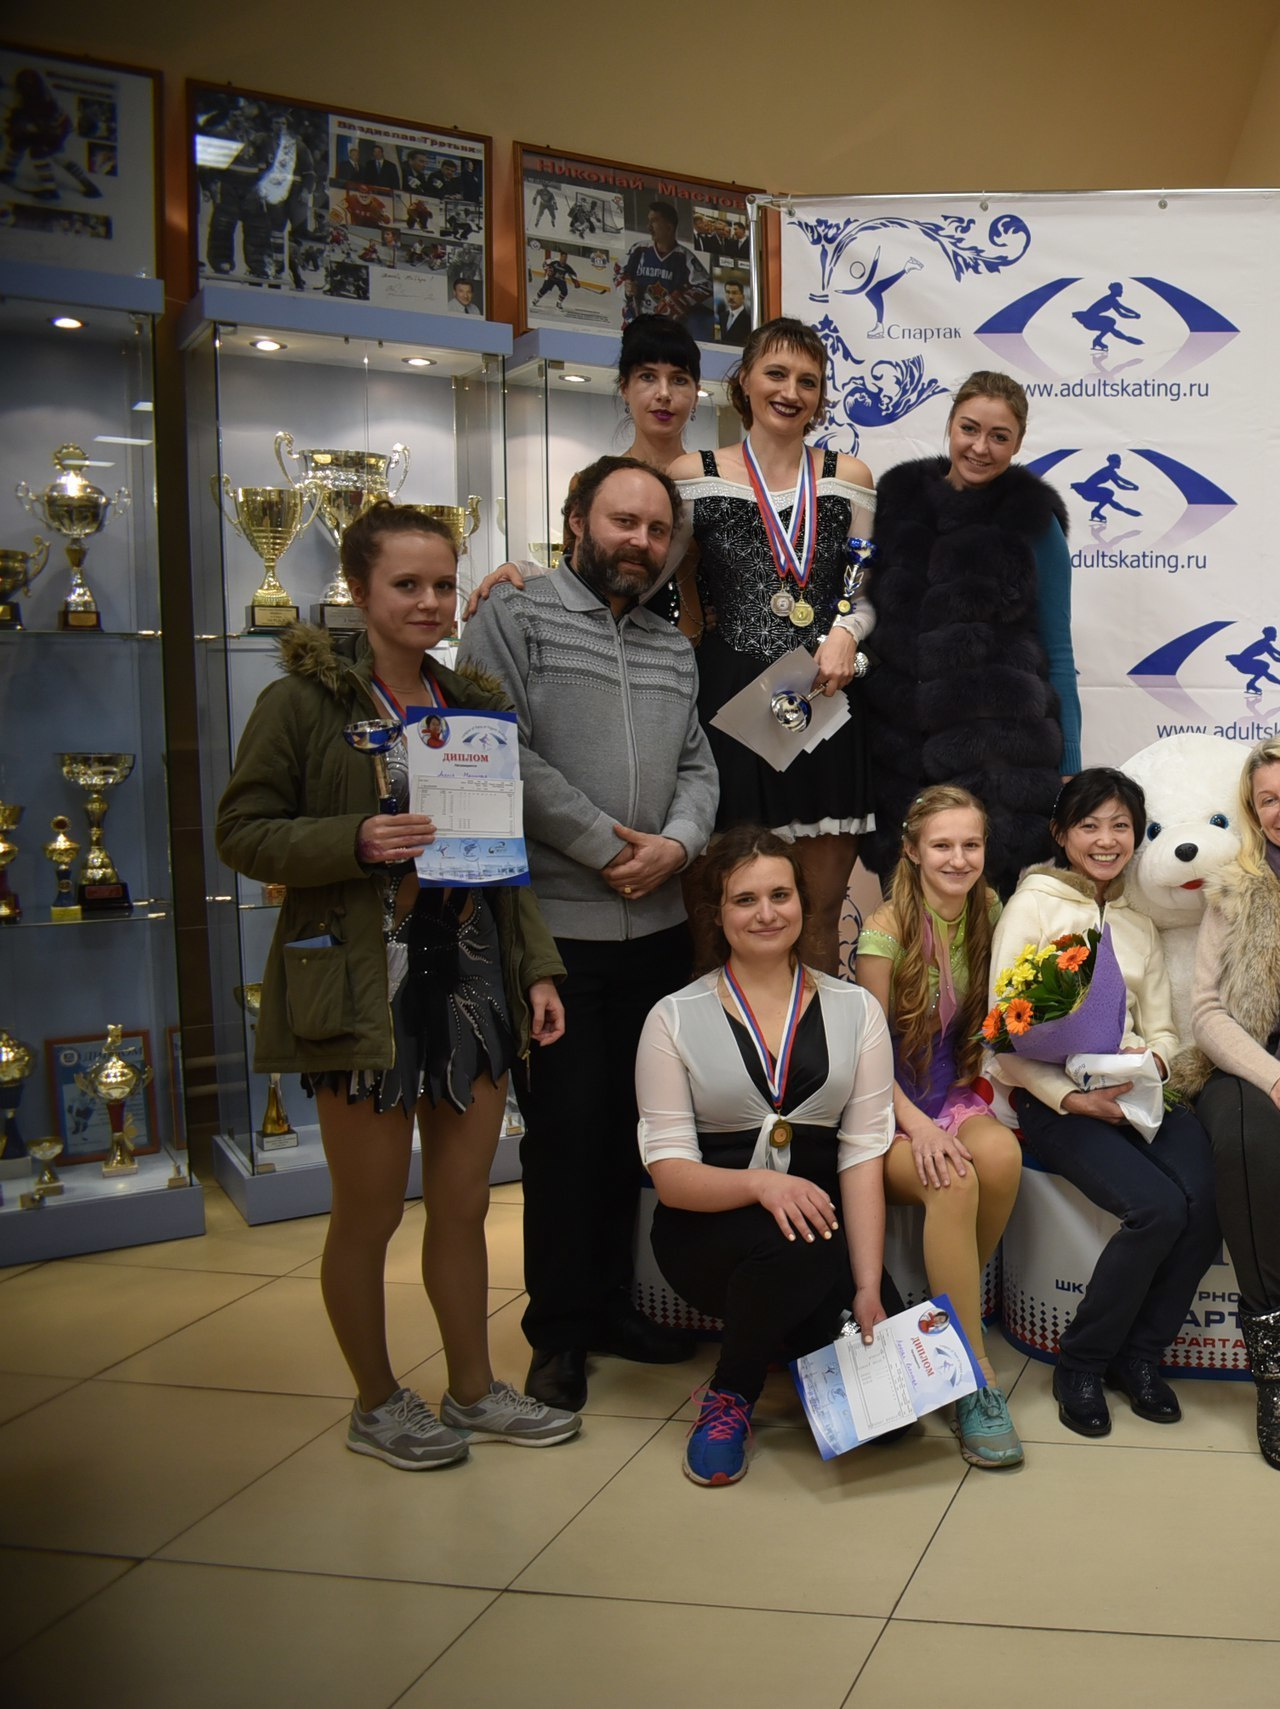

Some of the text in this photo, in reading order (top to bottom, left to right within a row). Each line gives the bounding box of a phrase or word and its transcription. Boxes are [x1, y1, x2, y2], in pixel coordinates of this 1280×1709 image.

[536, 159, 746, 211] Николай Маслов
[887, 324, 962, 343] Спартак
[1020, 378, 1210, 402] ww.adultskating.ru
[1070, 550, 1207, 574] dultskating.ru
[442, 752, 489, 764] ДИПЛОМ
[911, 1336, 936, 1378] ДИПЛОМ
